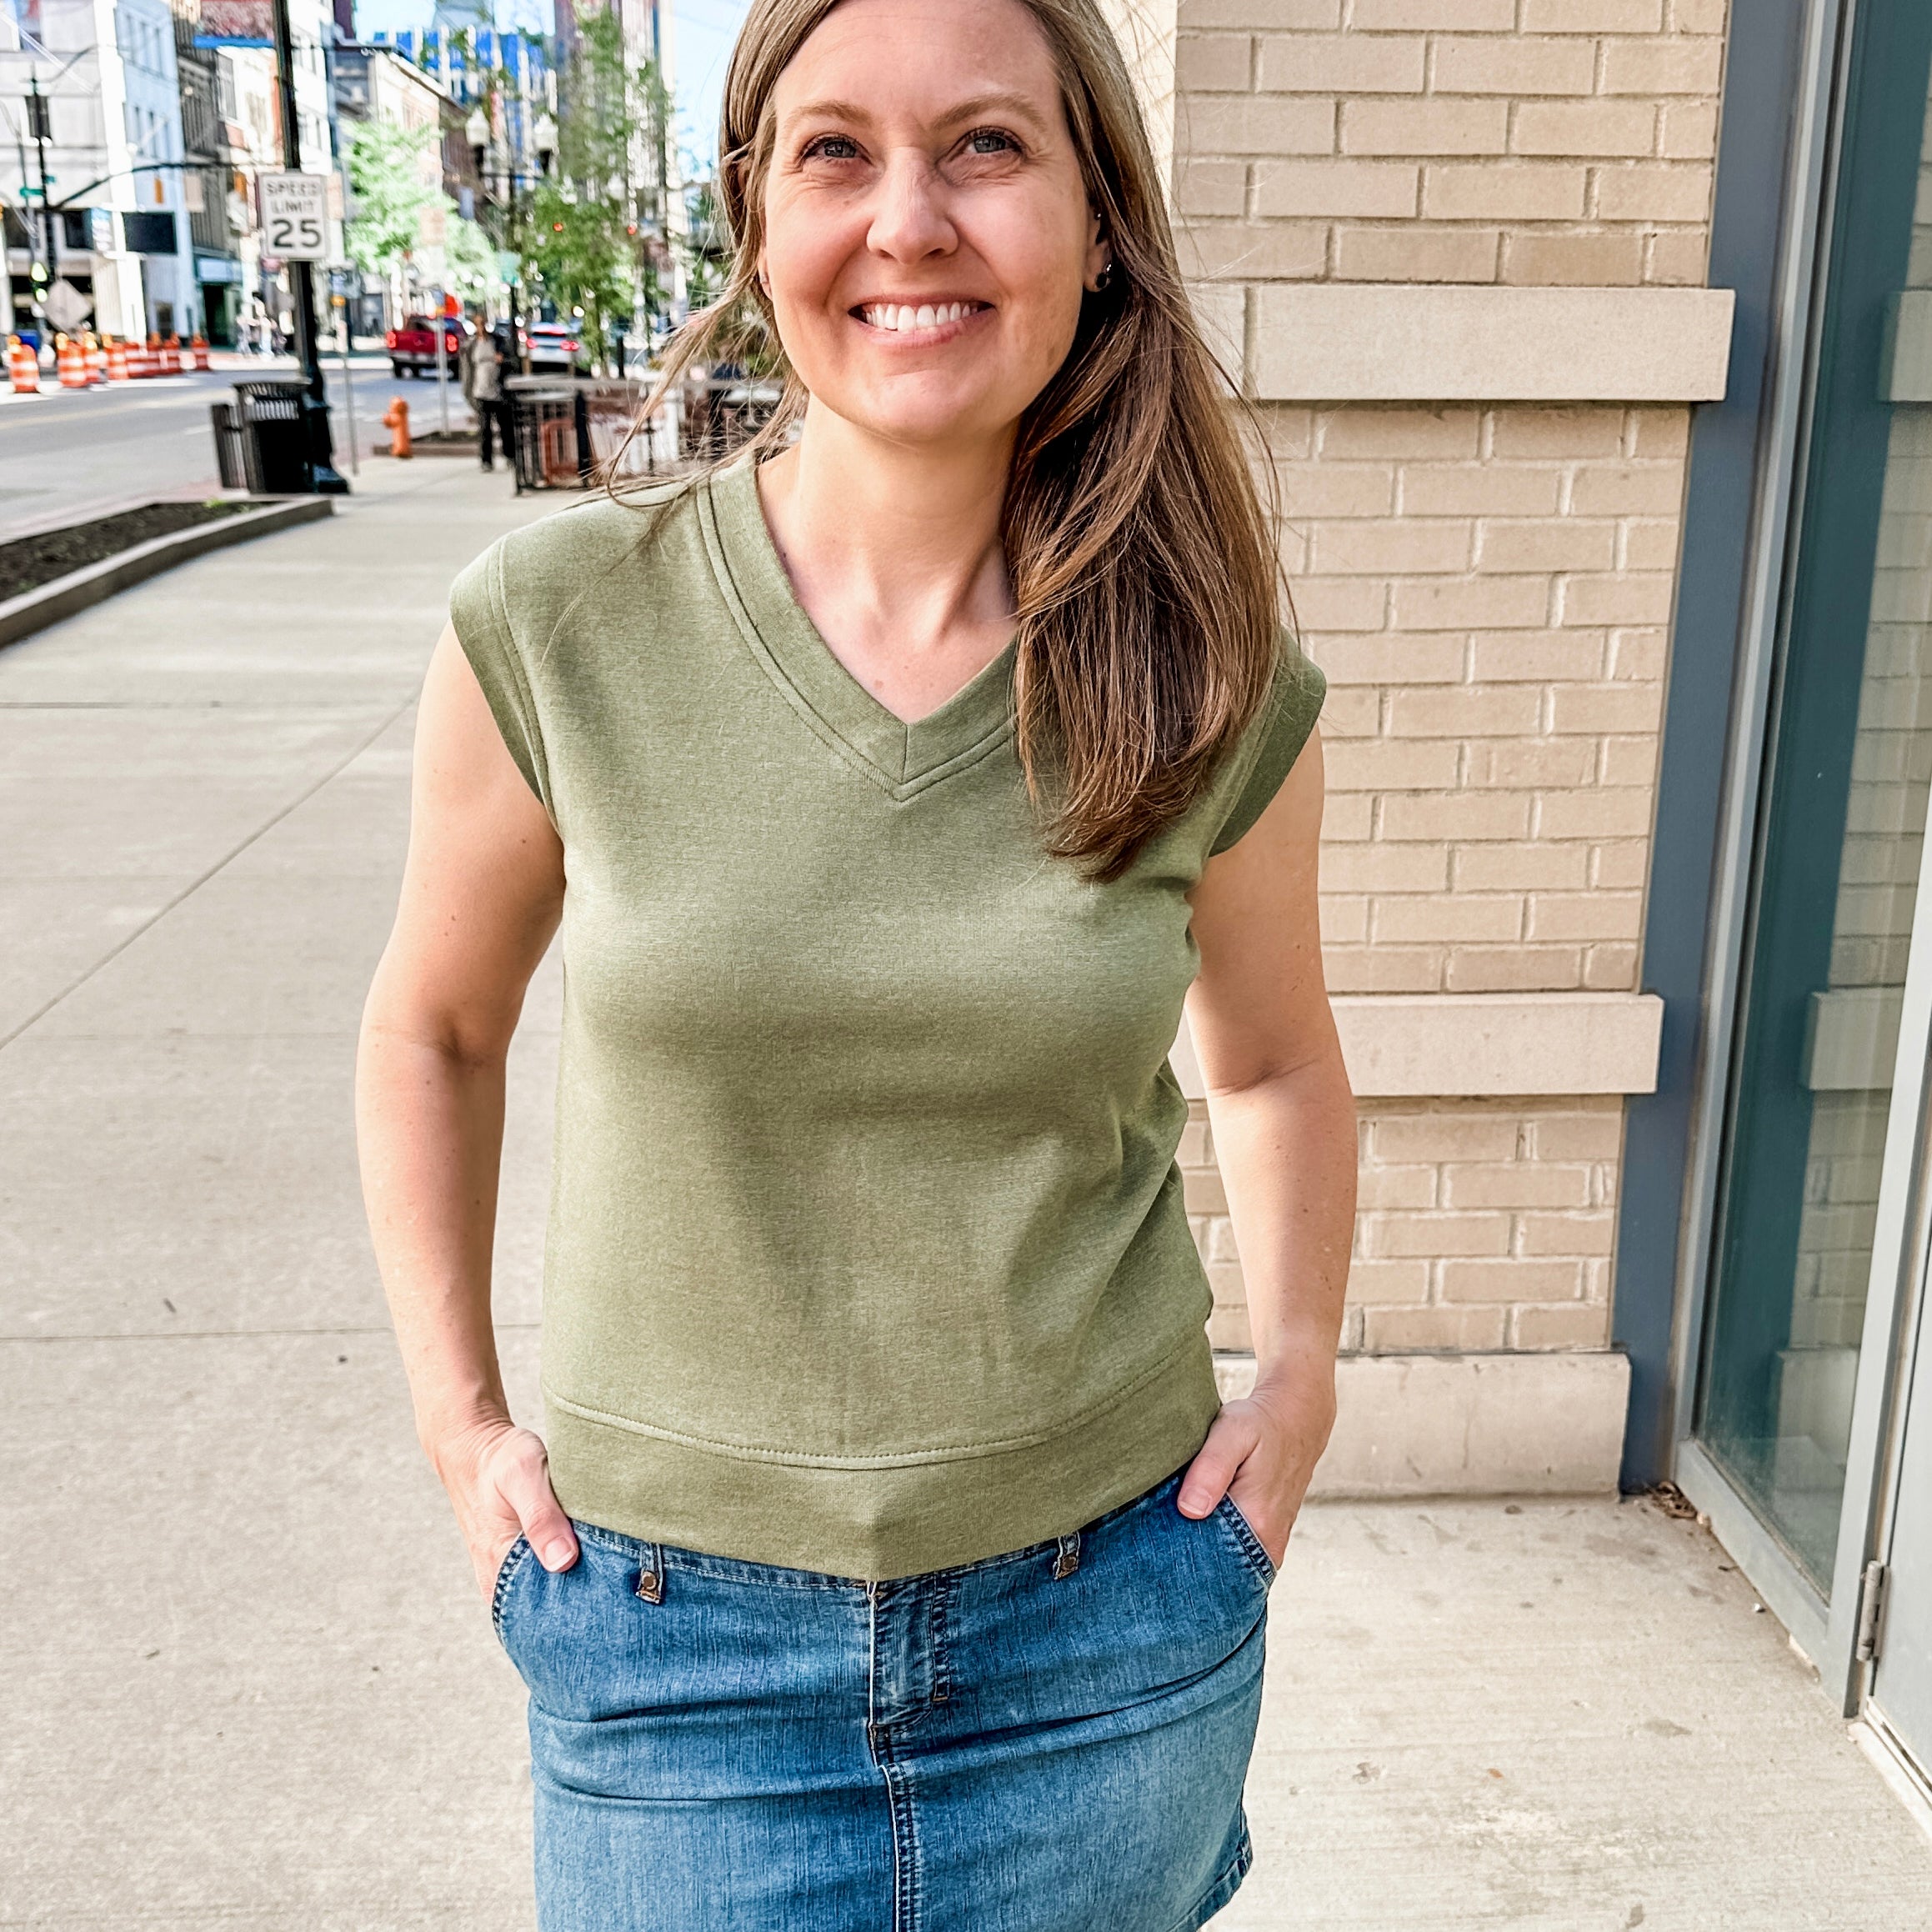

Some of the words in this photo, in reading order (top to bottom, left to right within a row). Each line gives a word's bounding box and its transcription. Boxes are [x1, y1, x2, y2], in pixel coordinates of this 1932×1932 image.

[266, 181, 320, 196] SPEED
[271, 199, 315, 214] LIMIT
[272, 218, 322, 248] 25
